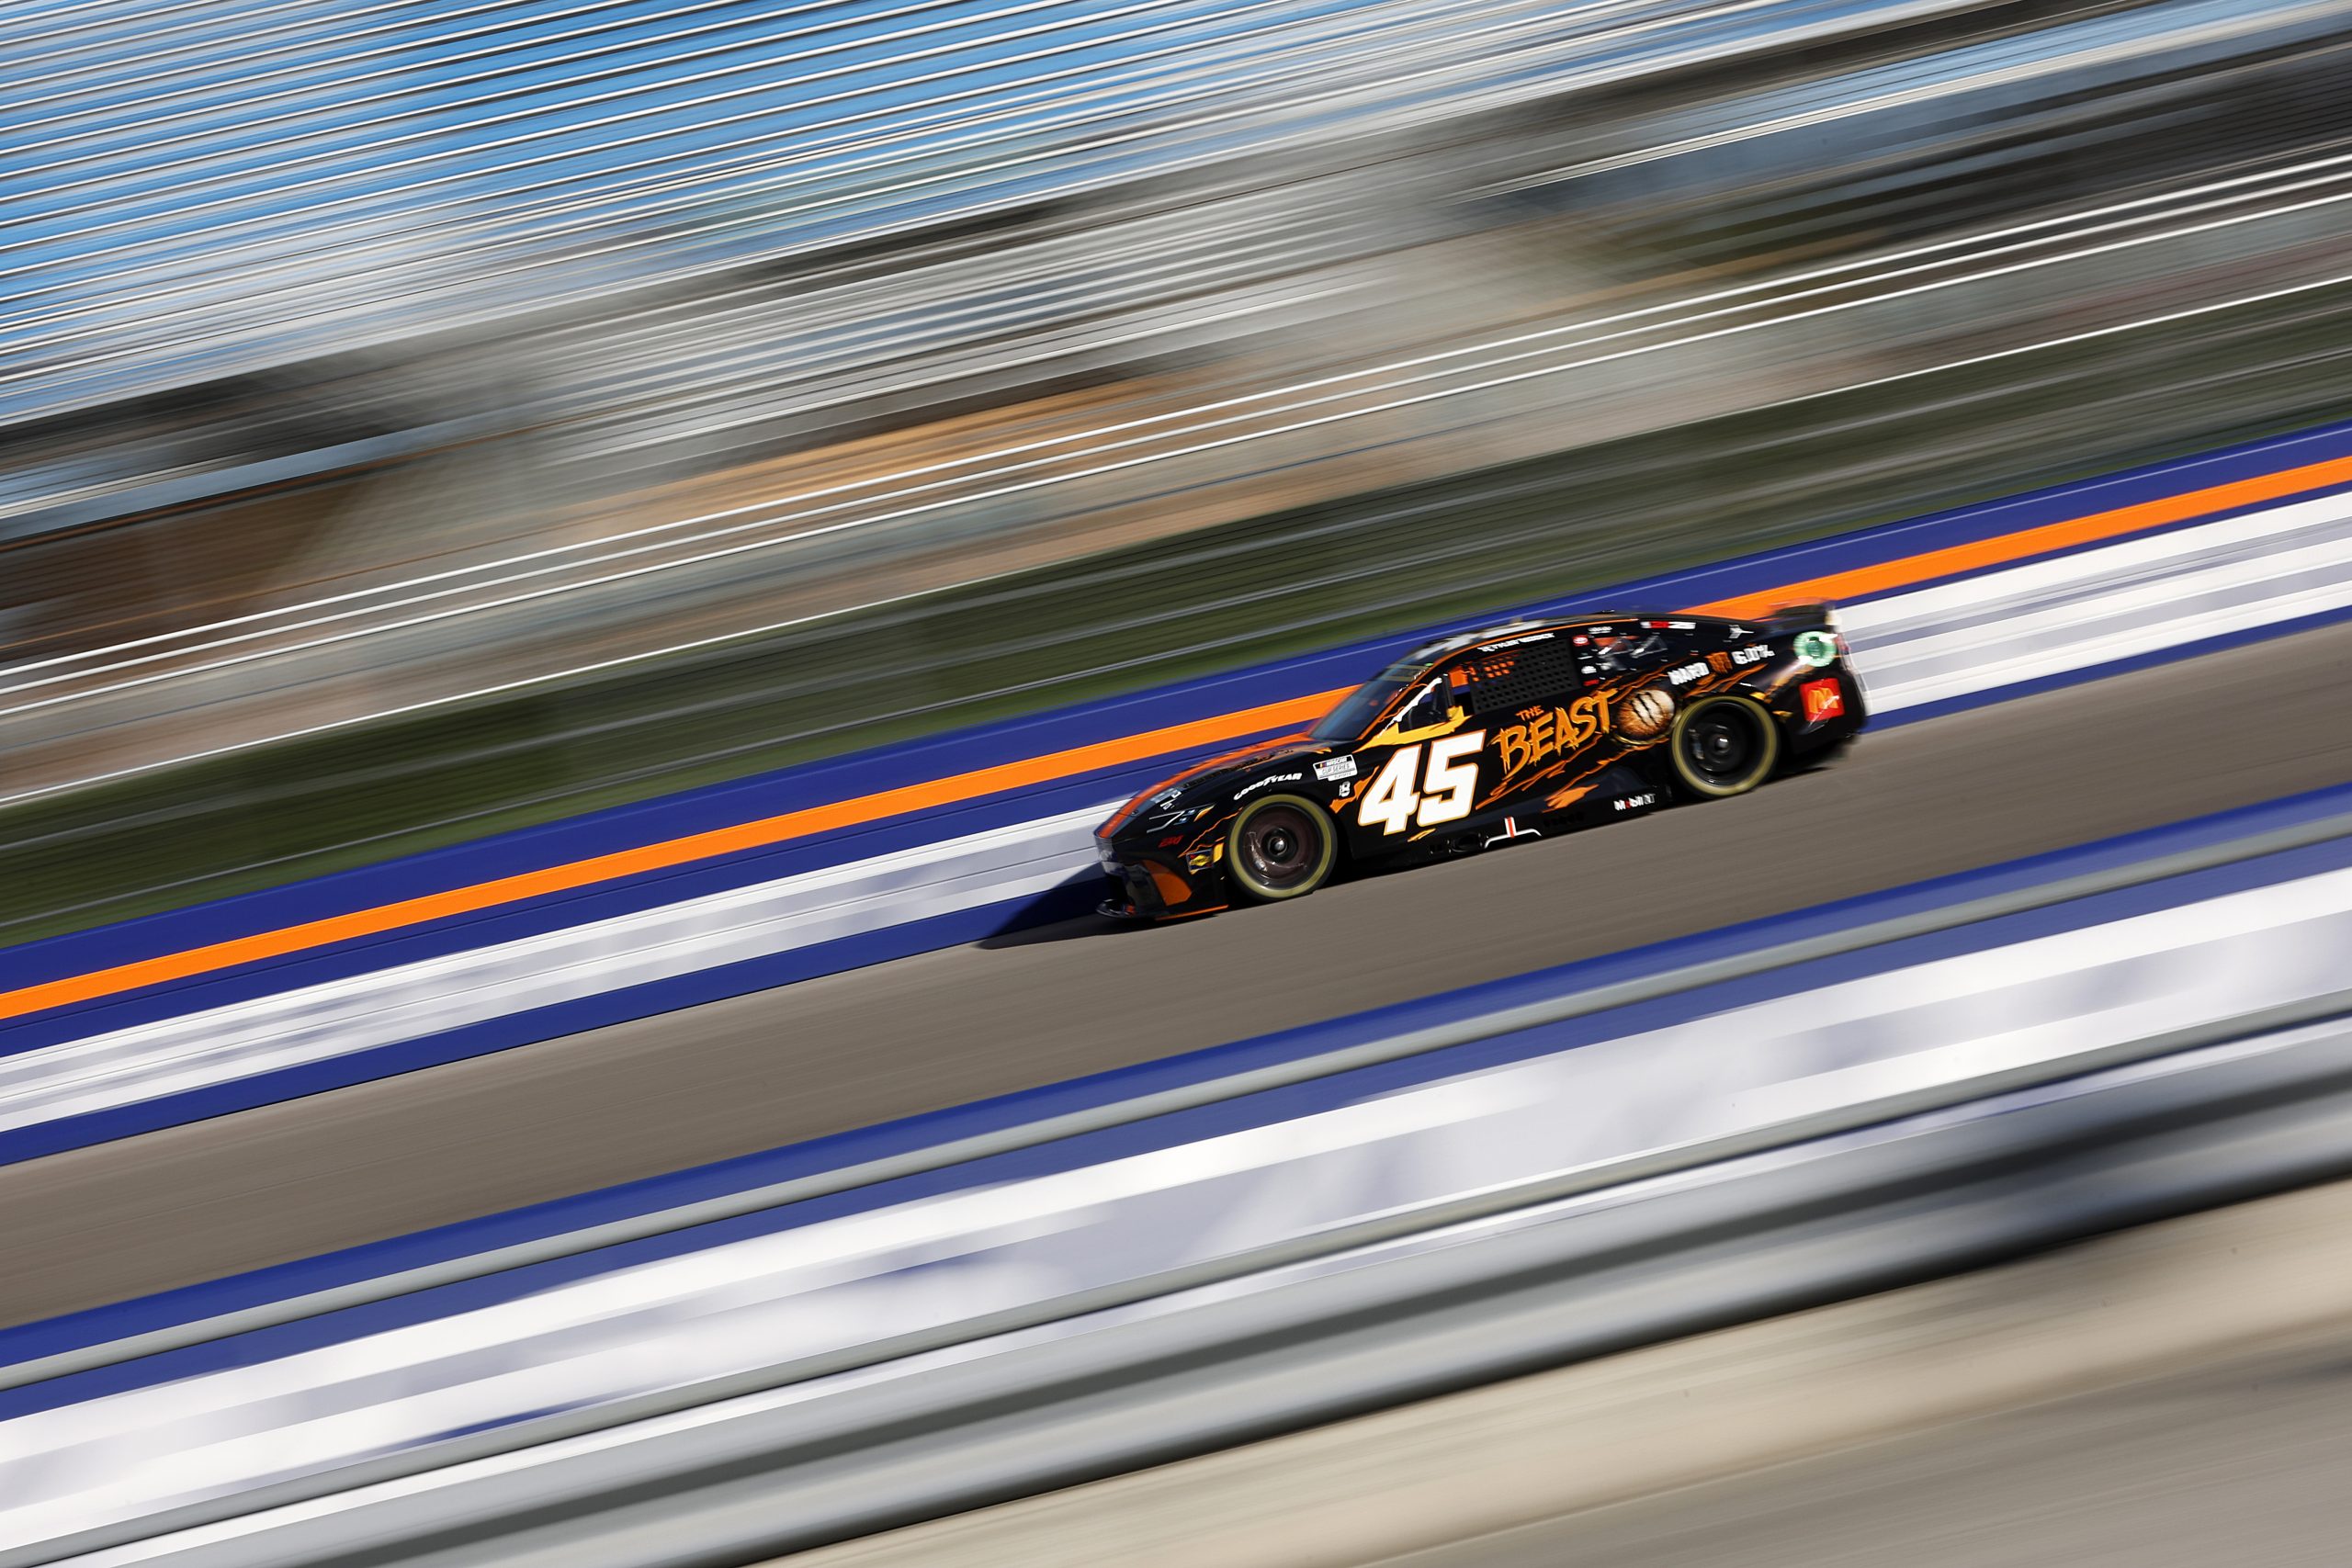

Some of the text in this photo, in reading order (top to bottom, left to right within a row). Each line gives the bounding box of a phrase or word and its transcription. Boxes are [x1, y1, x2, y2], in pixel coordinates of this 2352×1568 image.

[1516, 705, 1544, 722] THE
[1493, 689, 1619, 781] BEAST
[1233, 773, 1303, 801] GOODYEAR
[1358, 728, 1487, 837] 45
[1613, 795, 1644, 810] Mobil
